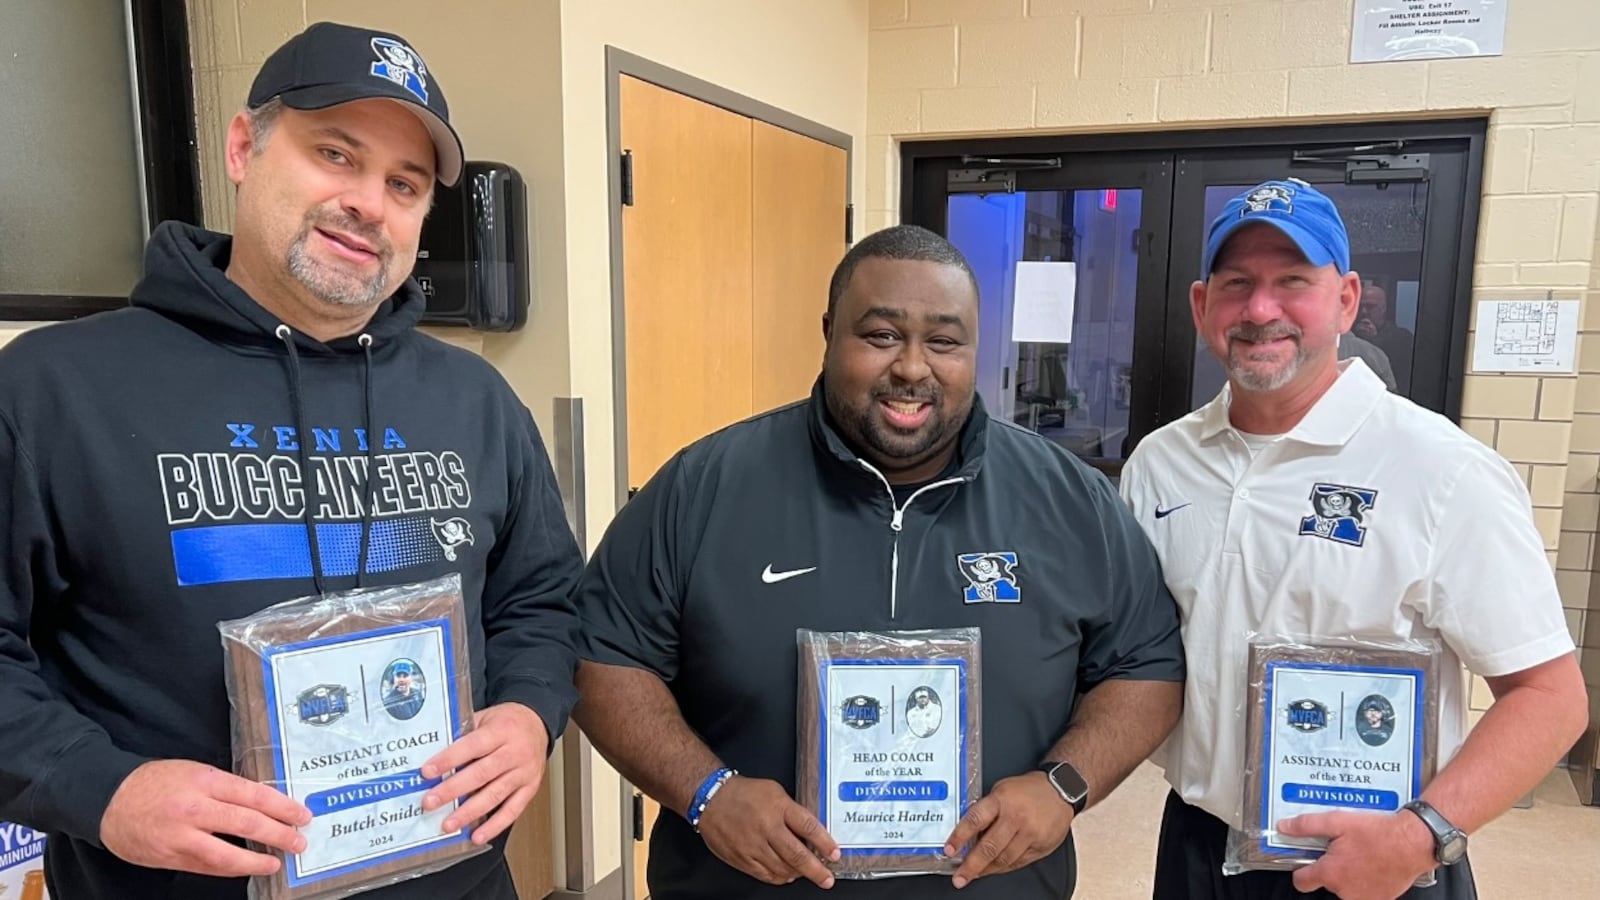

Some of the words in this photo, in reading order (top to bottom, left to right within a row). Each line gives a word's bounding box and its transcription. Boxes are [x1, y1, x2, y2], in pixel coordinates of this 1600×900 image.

[226, 423, 406, 451] XENIA
[157, 451, 471, 524] BUCCANEERS
[299, 743, 383, 772] ASSISTANT
[386, 731, 440, 753] COACH
[853, 752, 888, 762] HEAD
[890, 752, 934, 762] COACH
[337, 767, 350, 780] of
[351, 765, 369, 778] the
[371, 756, 409, 772] YEAR
[865, 767, 876, 776] of
[876, 767, 890, 776] the
[892, 767, 922, 776] YEAR
[1281, 755, 1352, 768] ASSISTANT
[1354, 759, 1400, 772] COACH
[1310, 771, 1320, 780] of
[1322, 772, 1336, 782] the
[1338, 773, 1372, 784] YEAR
[326, 782, 404, 807] DIVISION
[410, 774, 423, 787] II
[855, 786, 916, 796] DIVISION
[921, 786, 931, 796] II
[1298, 789, 1365, 804] DIVISION
[1369, 795, 1380, 804] II
[843, 810, 895, 823] Maurice
[898, 810, 944, 822] Harden
[330, 812, 376, 838] Butch
[368, 834, 394, 848] 2024
